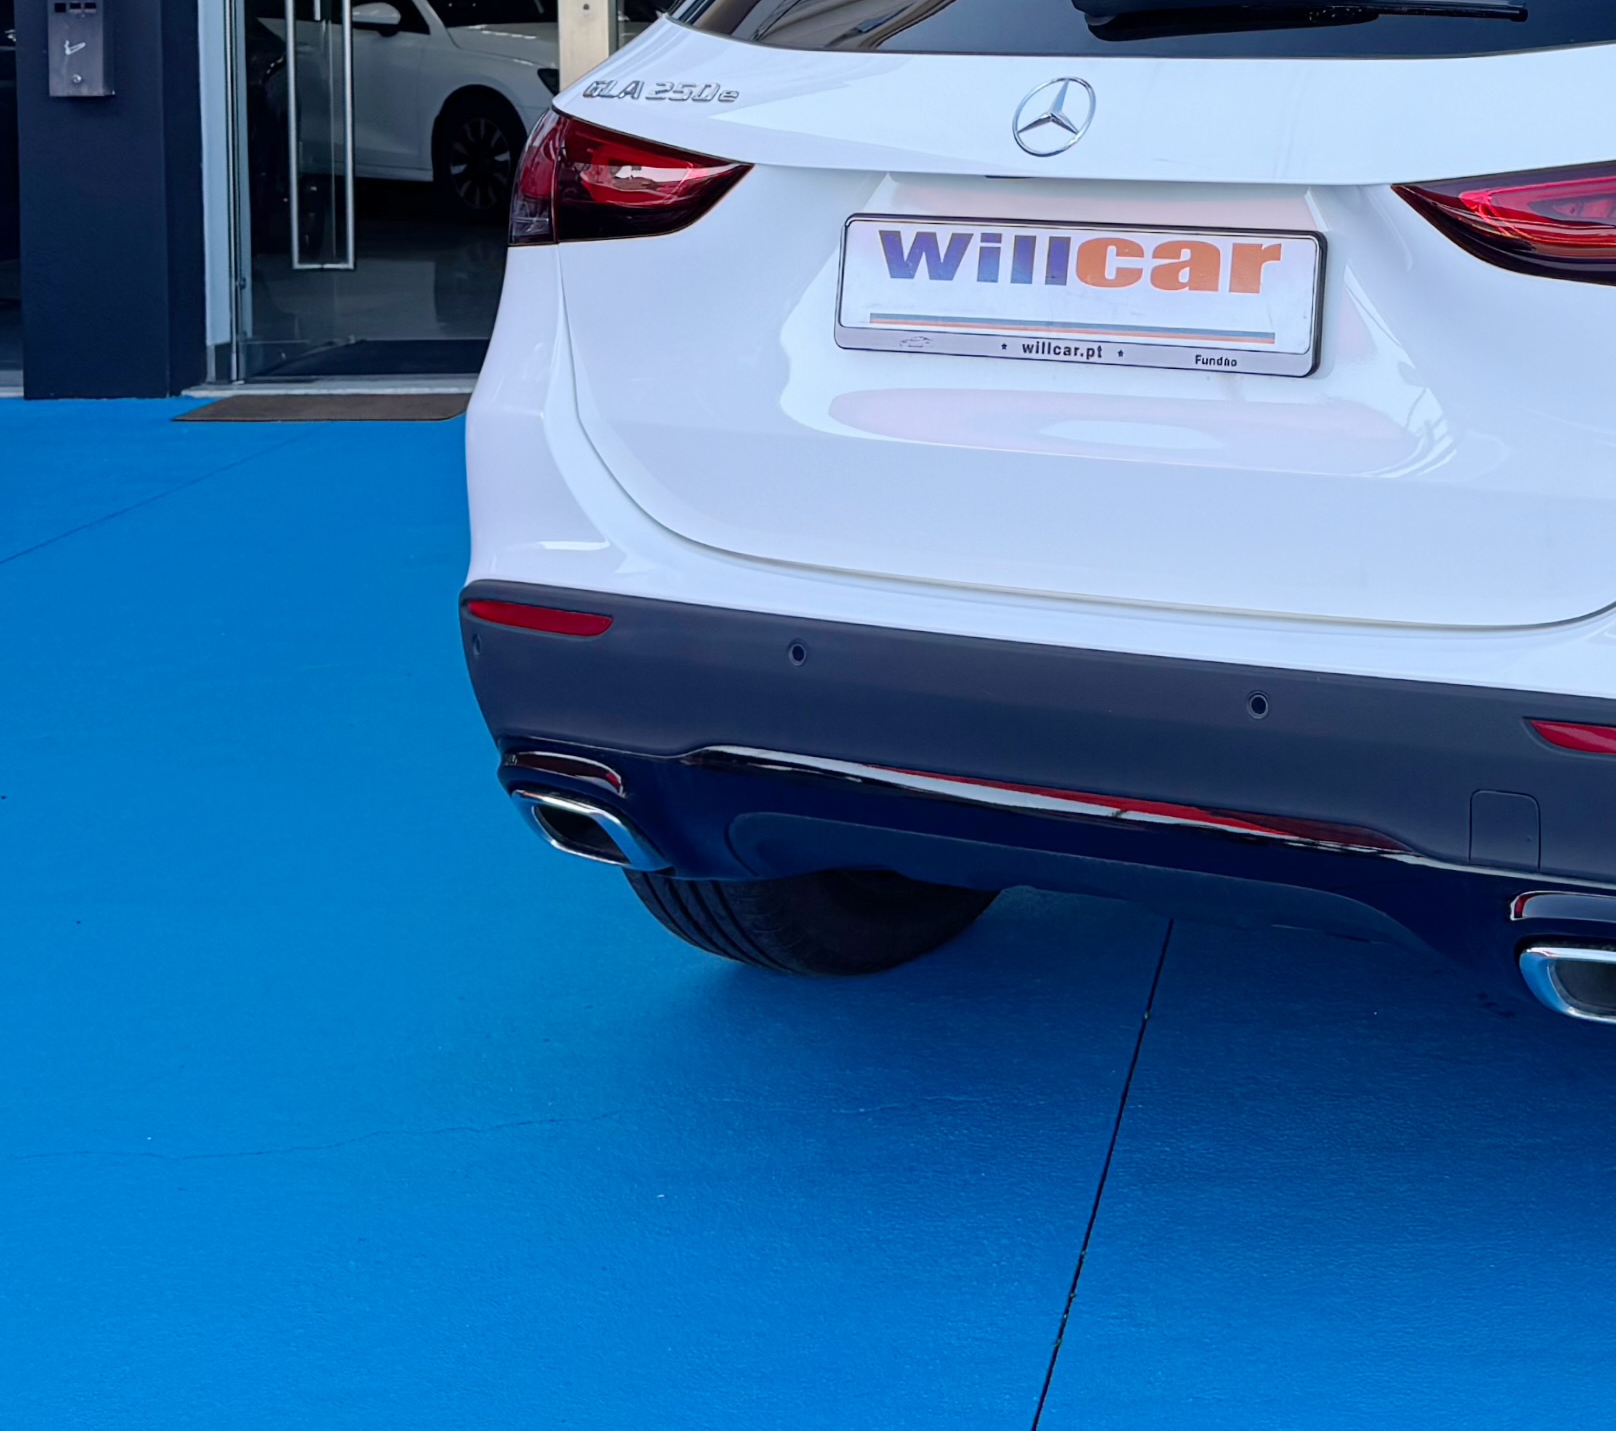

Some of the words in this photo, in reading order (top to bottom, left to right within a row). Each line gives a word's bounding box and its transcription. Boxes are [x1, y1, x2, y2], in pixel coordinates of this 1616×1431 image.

[583, 80, 644, 100] GLA
[878, 229, 1282, 294] willcar
[1021, 340, 1103, 360] willcar.pt
